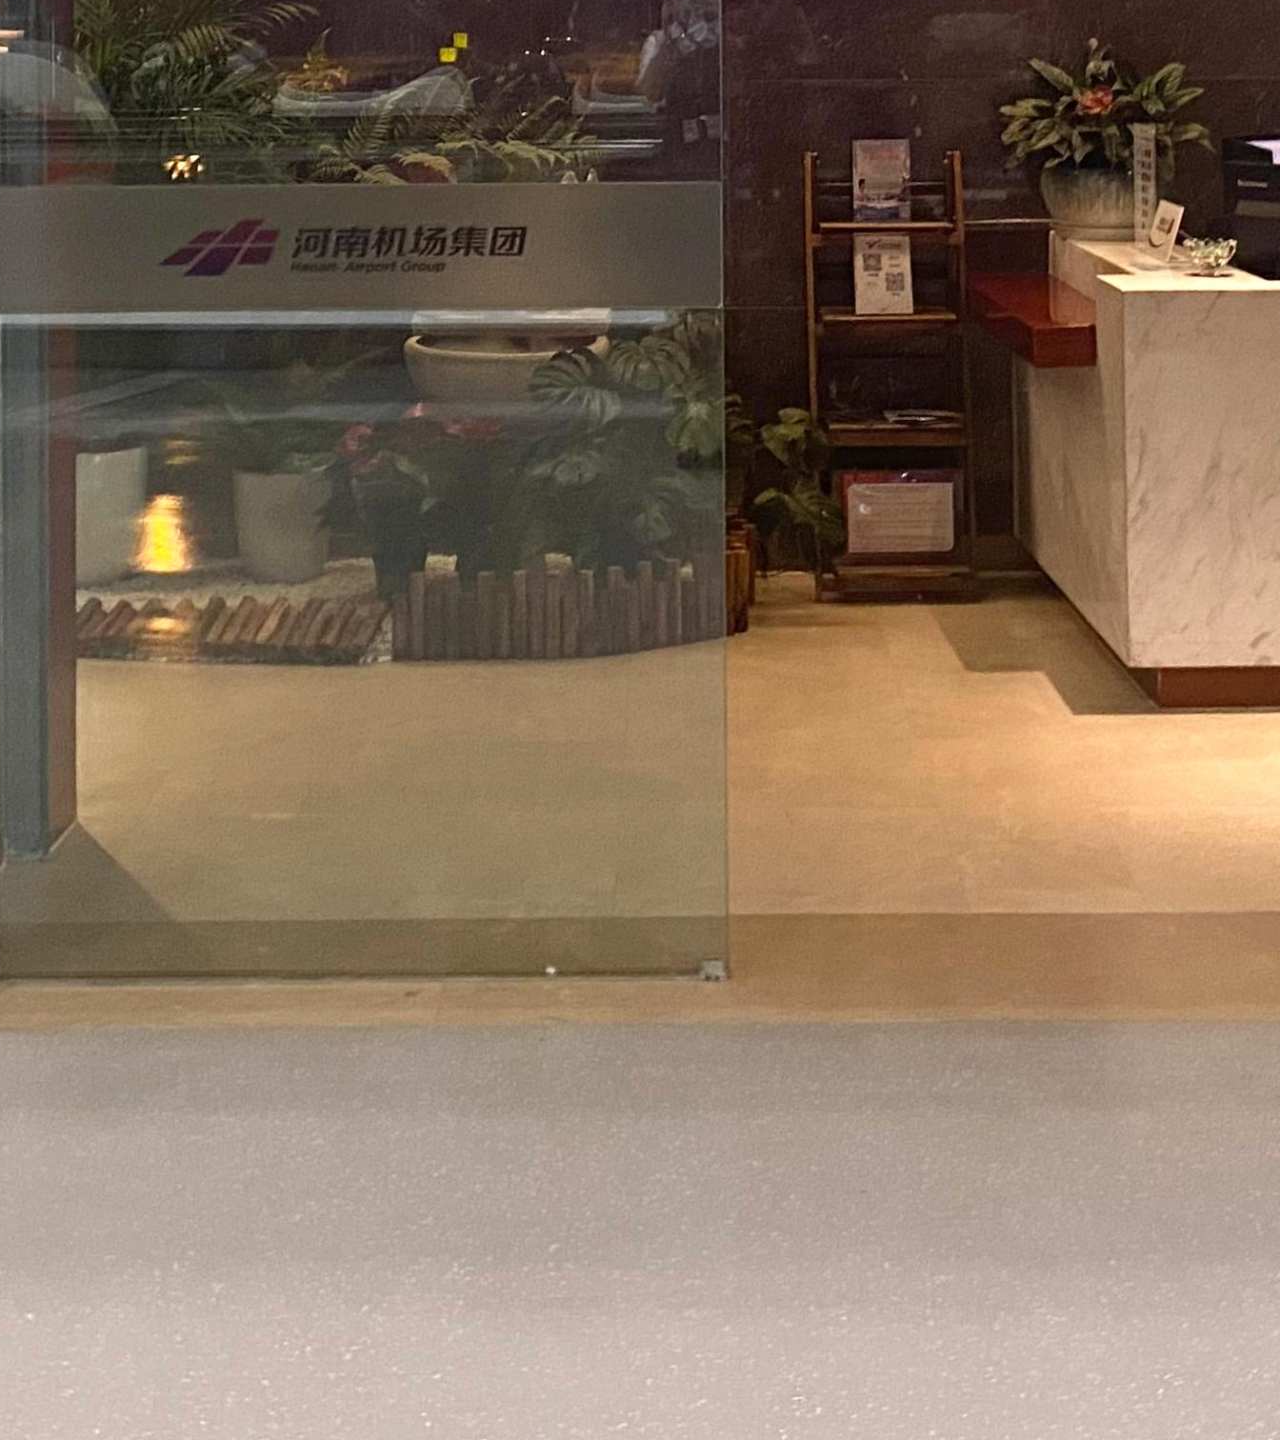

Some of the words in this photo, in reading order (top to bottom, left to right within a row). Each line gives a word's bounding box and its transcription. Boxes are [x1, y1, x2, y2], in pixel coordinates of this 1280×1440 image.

[291, 225, 528, 259] 河南机场集团
[343, 261, 397, 274] Airport
[400, 260, 447, 273] Group
